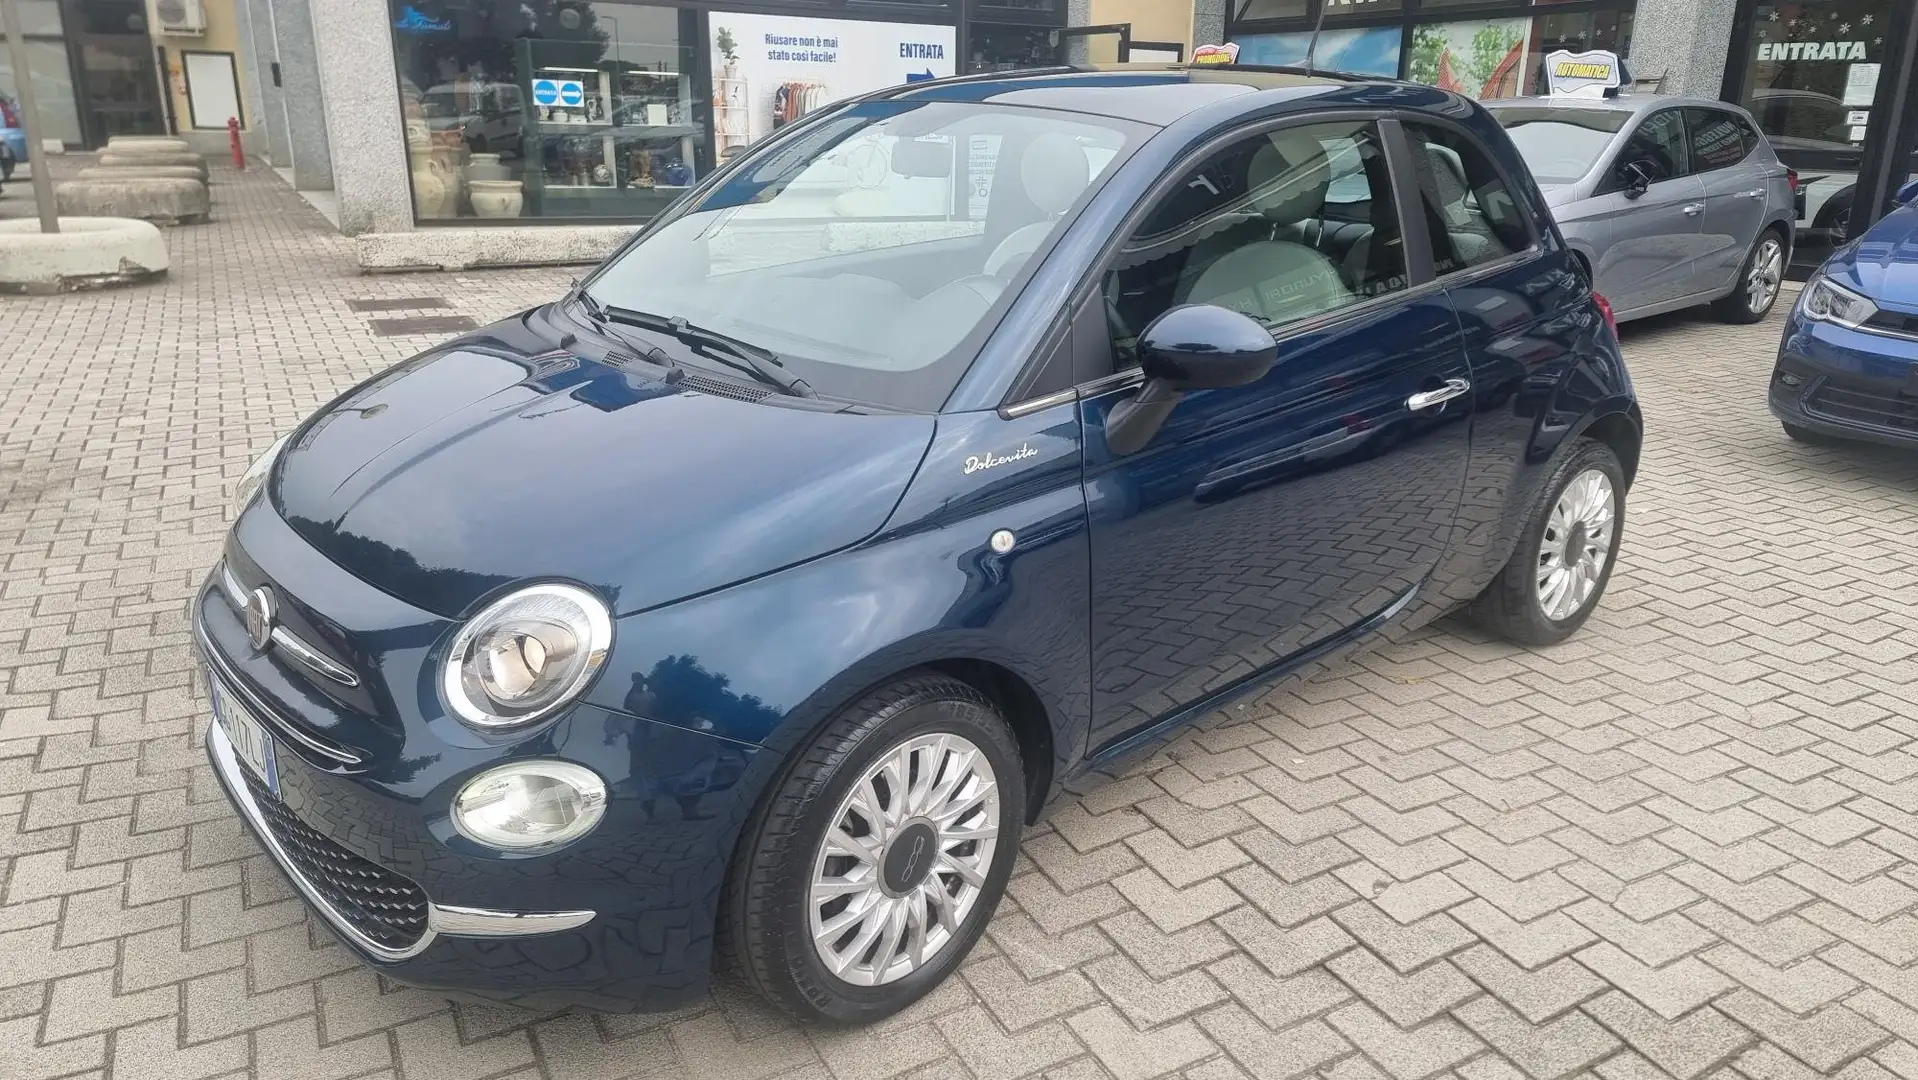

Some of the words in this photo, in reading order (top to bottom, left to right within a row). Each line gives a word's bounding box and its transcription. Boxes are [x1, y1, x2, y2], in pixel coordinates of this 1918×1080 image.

[765, 33, 798, 46] Riusare
[799, 37, 815, 47] non
[816, 36, 822, 47] è
[823, 36, 839, 48] mai
[767, 50, 790, 61] stato
[810, 51, 837, 63] facile!
[899, 42, 944, 60] ENTRATA
[1757, 41, 1867, 61] ENTRATA
[1555, 62, 1611, 80] AUTOMATICA
[964, 443, 1038, 475] Dolcevita
